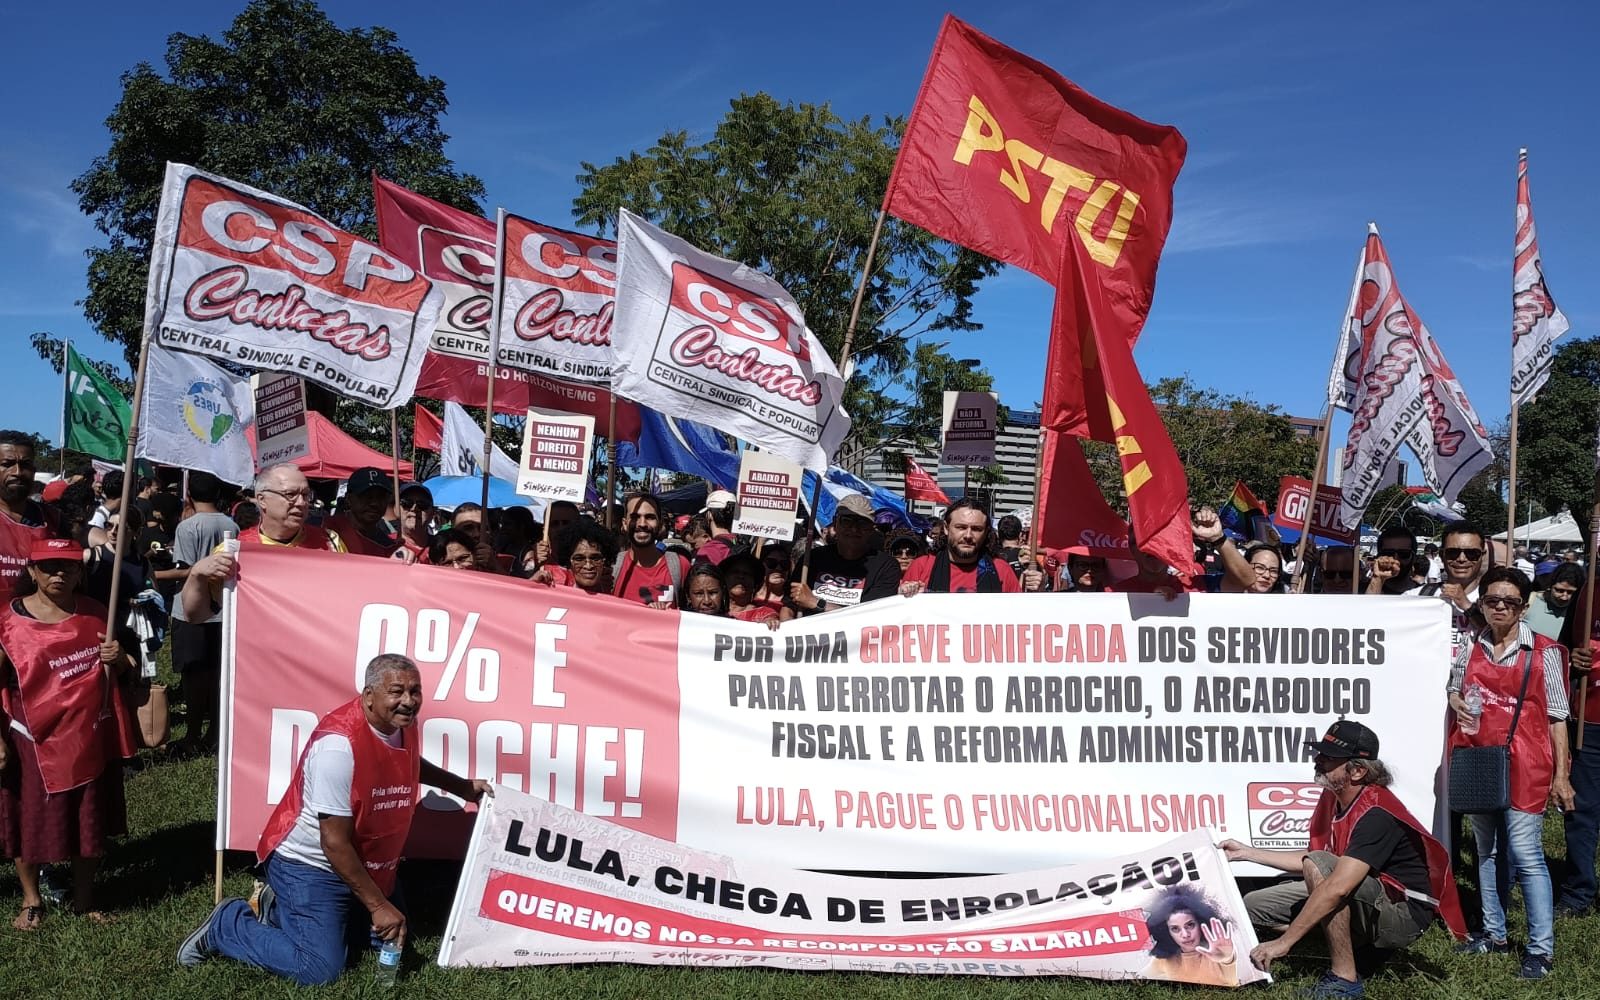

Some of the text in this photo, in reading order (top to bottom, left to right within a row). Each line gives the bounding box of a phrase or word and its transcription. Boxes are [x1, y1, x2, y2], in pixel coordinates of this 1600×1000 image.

[952, 95, 1141, 268] PSTU
[201, 199, 416, 290] CSP
[521, 233, 616, 295] CS
[184, 264, 391, 360] Conlutas
[514, 288, 613, 346] Conl
[161, 325, 390, 401] CENTRAL SINDICAL E POPULAR
[436, 335, 490, 356] CENTRA
[498, 348, 612, 379] CENTRAL SINDICA
[670, 324, 823, 407] Conlutas
[513, 370, 597, 402] HORIZONTE/MG
[653, 366, 818, 438] CENTRAL SINDICAL E POPULAR
[537, 424, 580, 439] NENHUM
[537, 442, 577, 455] DIREITO
[533, 459, 578, 473] A MENOS
[751, 472, 786, 483] ABAIXO A
[741, 496, 793, 509] PREVIDÊNCIA!
[745, 485, 792, 497] REFORMA DA
[816, 585, 859, 599] Conlutas
[820, 573, 864, 588] CSP
[49, 644, 100, 670] Pela valoriza
[354, 603, 569, 708] 0% É
[713, 624, 1386, 666] POR UMA GREVE UNIFICADA DOS SERVIDORES
[59, 662, 91, 679] servidor
[728, 674, 1371, 721] PARA DERROTAR O ARROCHO, O ARCABOUÇO
[771, 721, 1318, 764] FISCAL E A REFORMA ADMINISTRATIVA
[266, 708, 646, 818] DOCHE!
[736, 785, 826, 832] LULA,
[836, 790, 934, 831] PAGUE
[943, 793, 966, 831] O
[973, 794, 1227, 833] FUNCIONALISMO!
[1256, 785, 1323, 808] CS
[1254, 839, 1292, 847] CENTRAL
[504, 820, 1201, 924] LULA, CHEGA DE ENROLAÇÃO!
[526, 861, 560, 881] CHEGA
[498, 889, 1139, 955] QUEREMOS NOSSA RECOMPOSIÇÃO SALARIAL!
